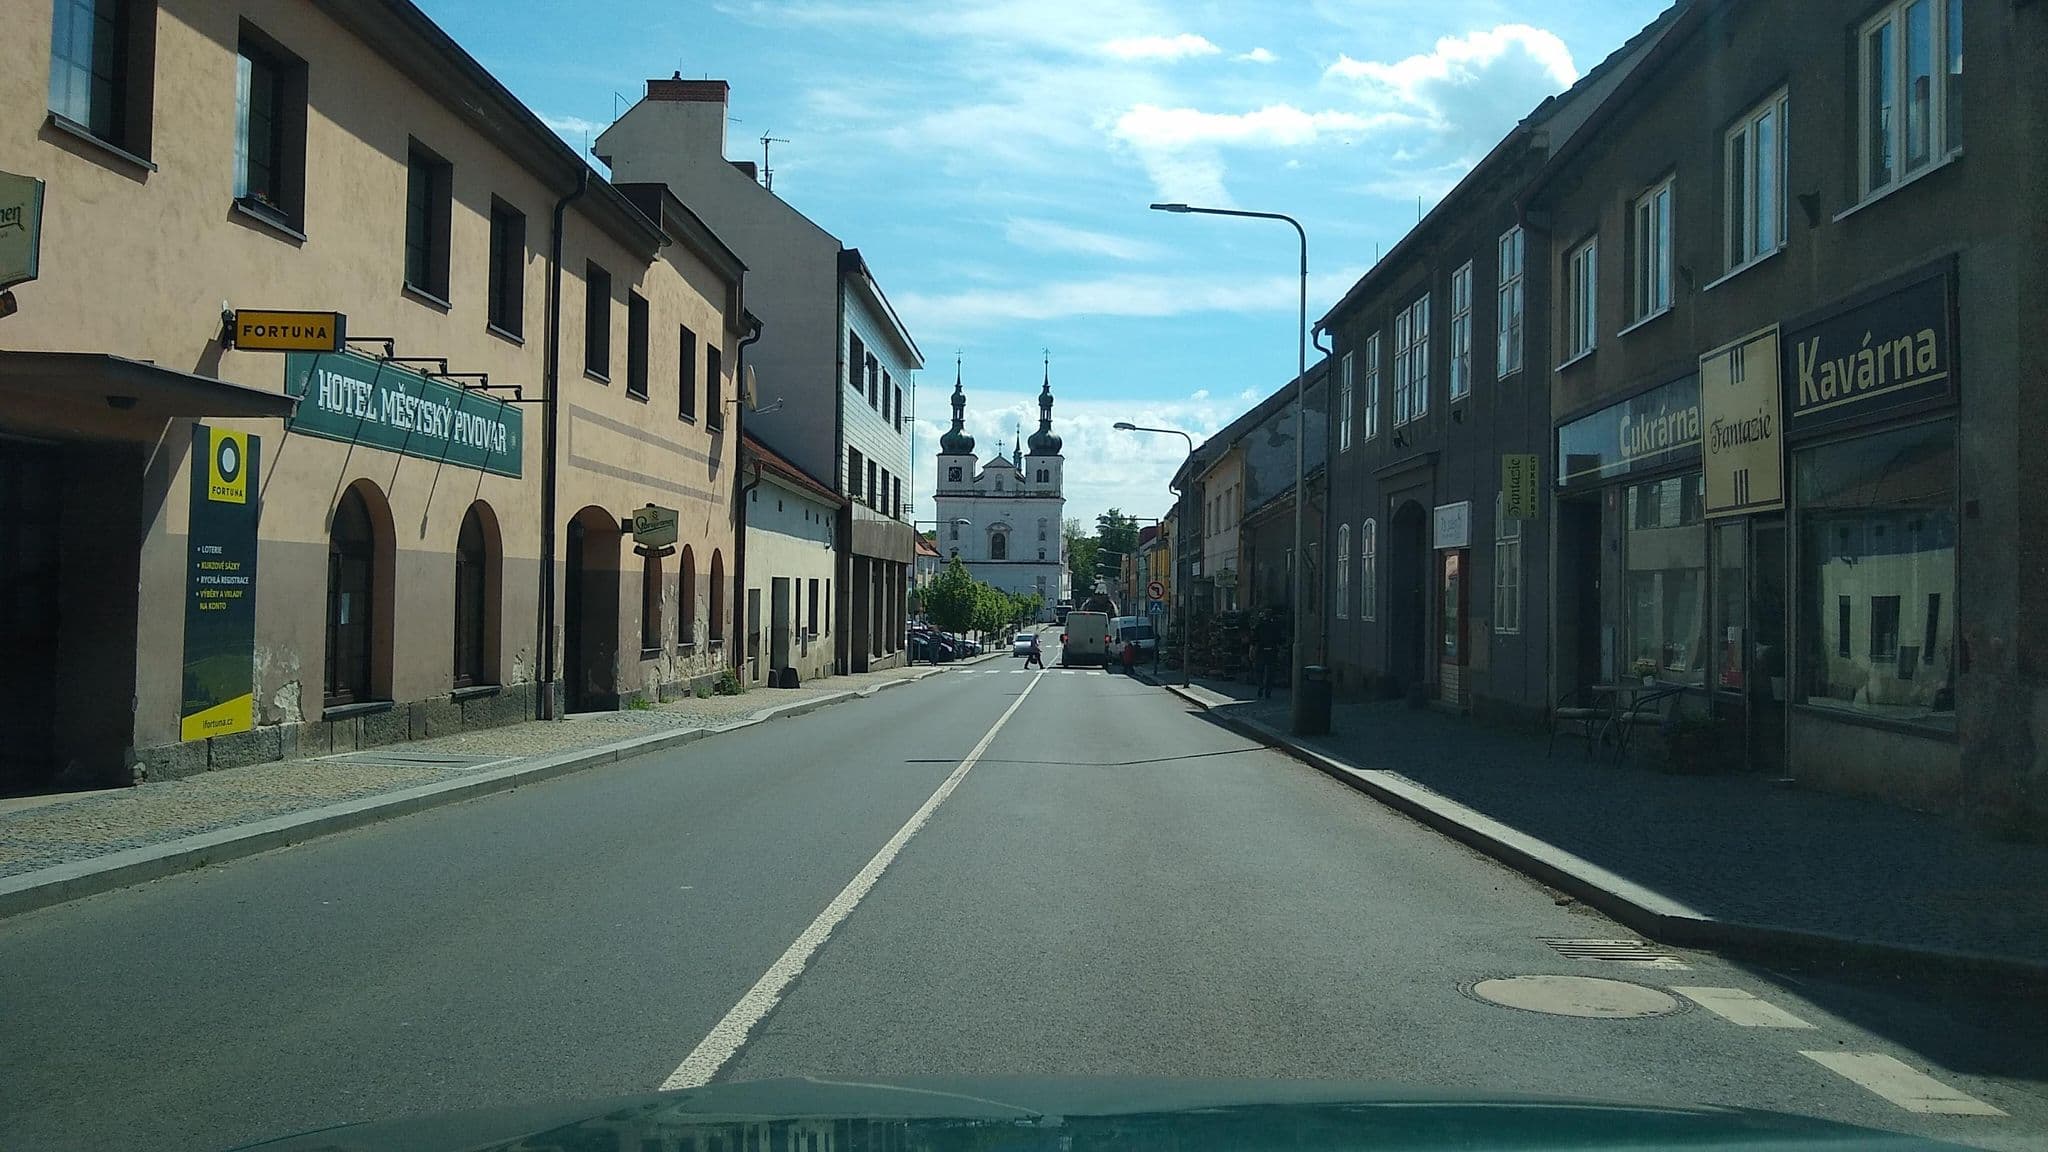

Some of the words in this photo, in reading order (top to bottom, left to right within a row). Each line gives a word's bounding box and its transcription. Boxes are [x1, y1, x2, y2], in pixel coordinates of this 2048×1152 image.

[243, 325, 327, 339] FORTUNA
[1797, 327, 1938, 407] Kavárna
[318, 369, 378, 424] HOTEL
[380, 382, 453, 442] MĚSTSKÝ
[453, 410, 508, 456] PIVOVAR
[1619, 404, 1700, 458] Cukrárna
[1710, 408, 1772, 454] Fantazie
[212, 486, 244, 497] FORTUNA
[201, 545, 223, 554] LOTERIE
[200, 575, 221, 584] RYCHLÁ
[208, 602, 227, 610] KONTO
